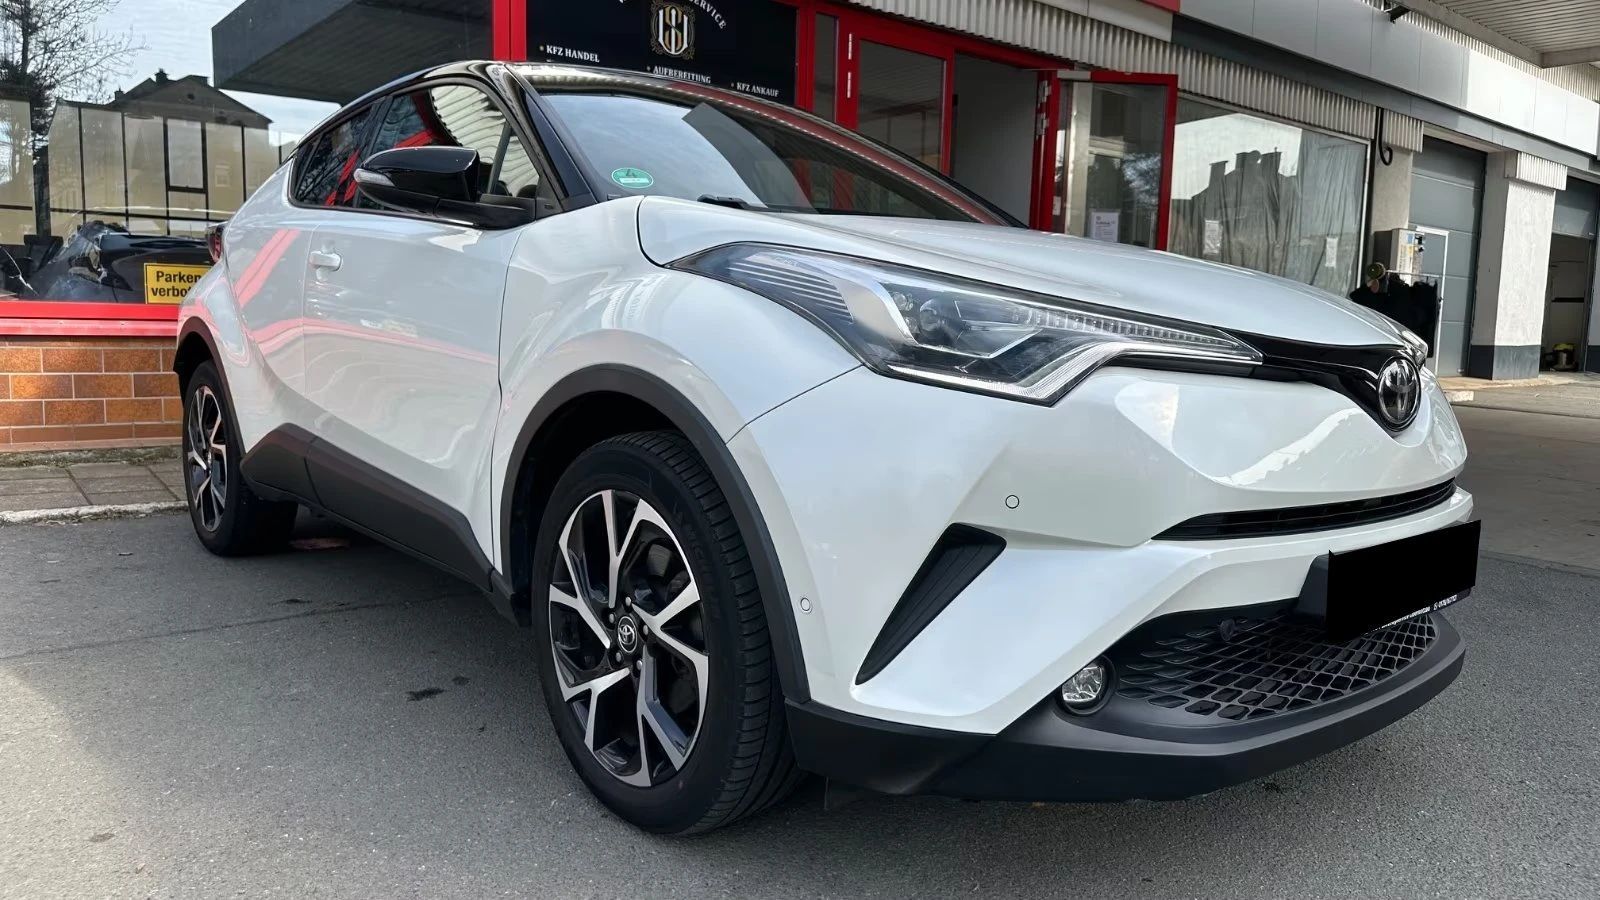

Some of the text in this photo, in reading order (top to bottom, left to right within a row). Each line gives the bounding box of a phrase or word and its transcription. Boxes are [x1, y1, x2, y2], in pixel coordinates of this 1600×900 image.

[689, 0, 727, 29] ERVICE
[546, 44, 600, 63] KFZ HANDEL
[653, 65, 711, 84] AUFBEREITUNG
[736, 82, 779, 98] KFZ ANKAUF
[156, 270, 202, 284] Parken
[151, 286, 191, 297] verbo
